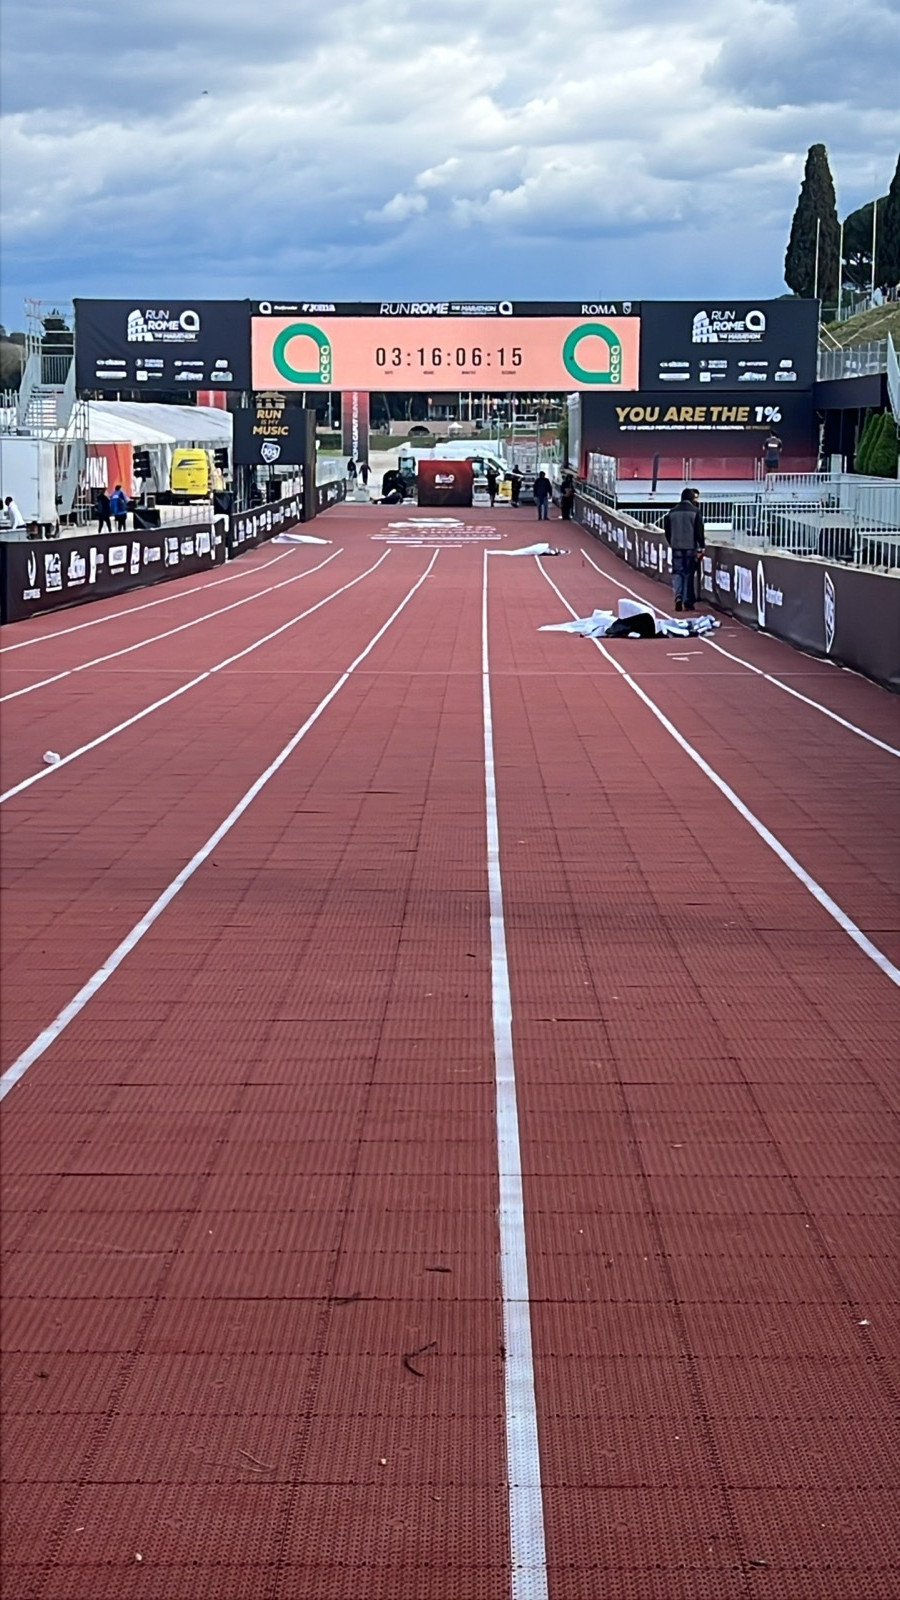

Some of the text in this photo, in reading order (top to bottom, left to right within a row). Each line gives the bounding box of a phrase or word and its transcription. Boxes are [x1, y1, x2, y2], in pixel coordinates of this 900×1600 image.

[581, 305, 617, 314] ROMA
[145, 310, 170, 320] RUN
[711, 310, 736, 320] RUN
[147, 321, 180, 330] ROME
[713, 321, 745, 331] ROME
[320, 345, 330, 383] acea
[610, 345, 620, 383] acea
[256, 409, 282, 419] RUN
[615, 406, 782, 423] YOU ARE THE 1%
[252, 426, 289, 436] MUSIC
